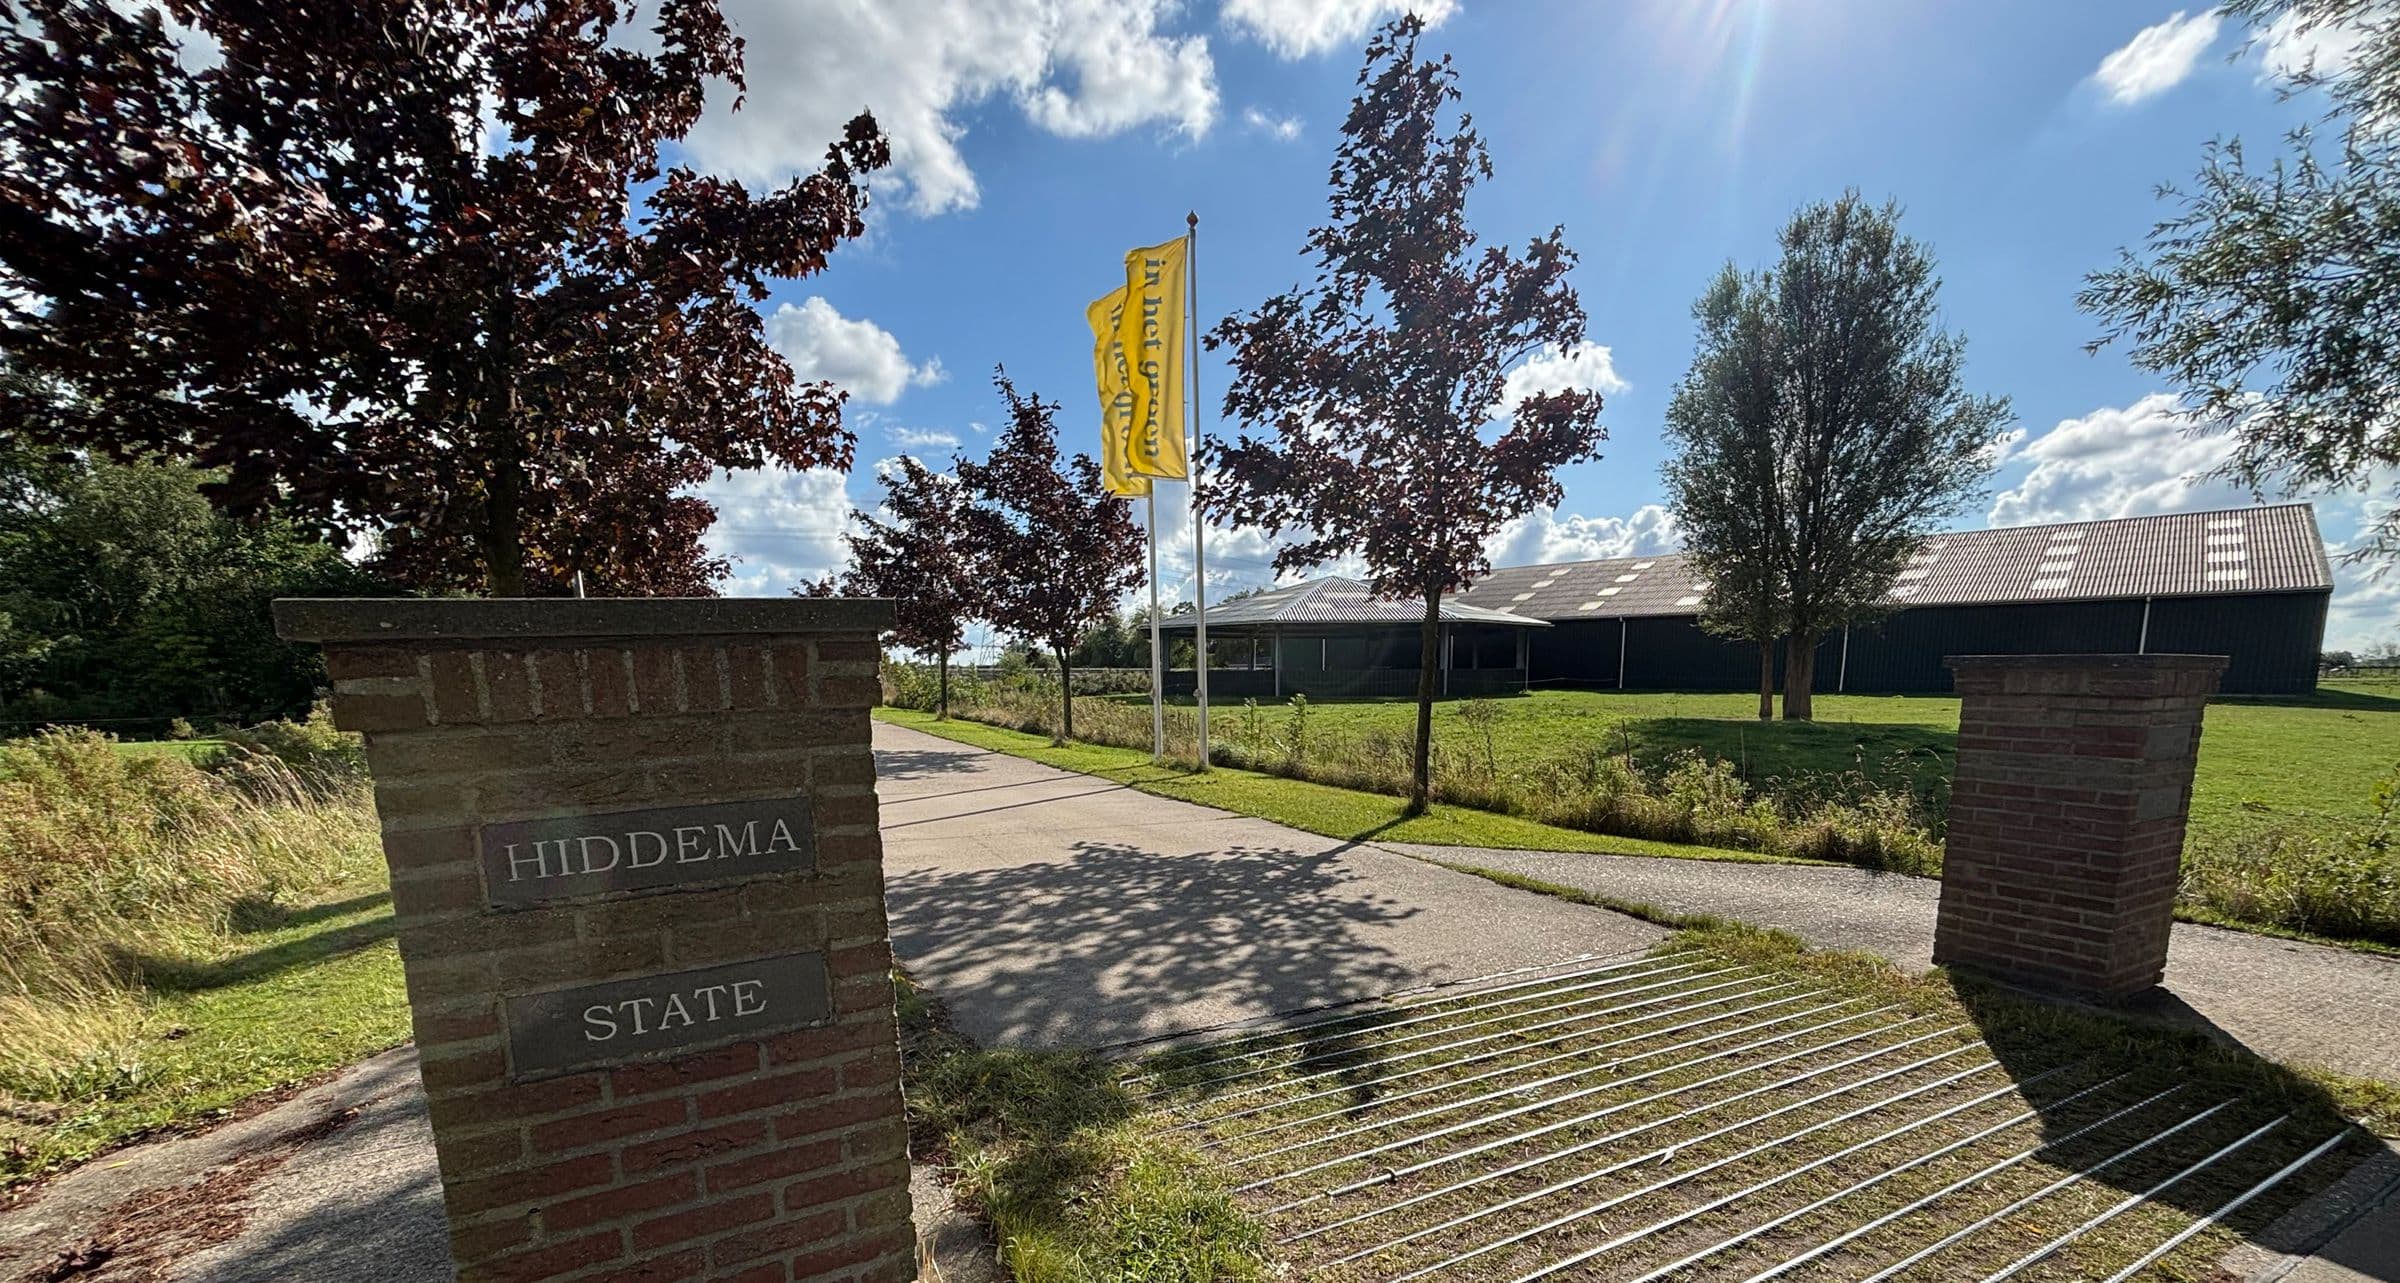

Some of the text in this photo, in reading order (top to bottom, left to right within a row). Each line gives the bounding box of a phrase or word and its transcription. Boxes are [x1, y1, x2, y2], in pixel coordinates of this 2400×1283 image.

[1139, 258, 1167, 458] in het groen
[504, 818, 801, 882] HIDDEMA
[582, 979, 767, 1041] STATE
